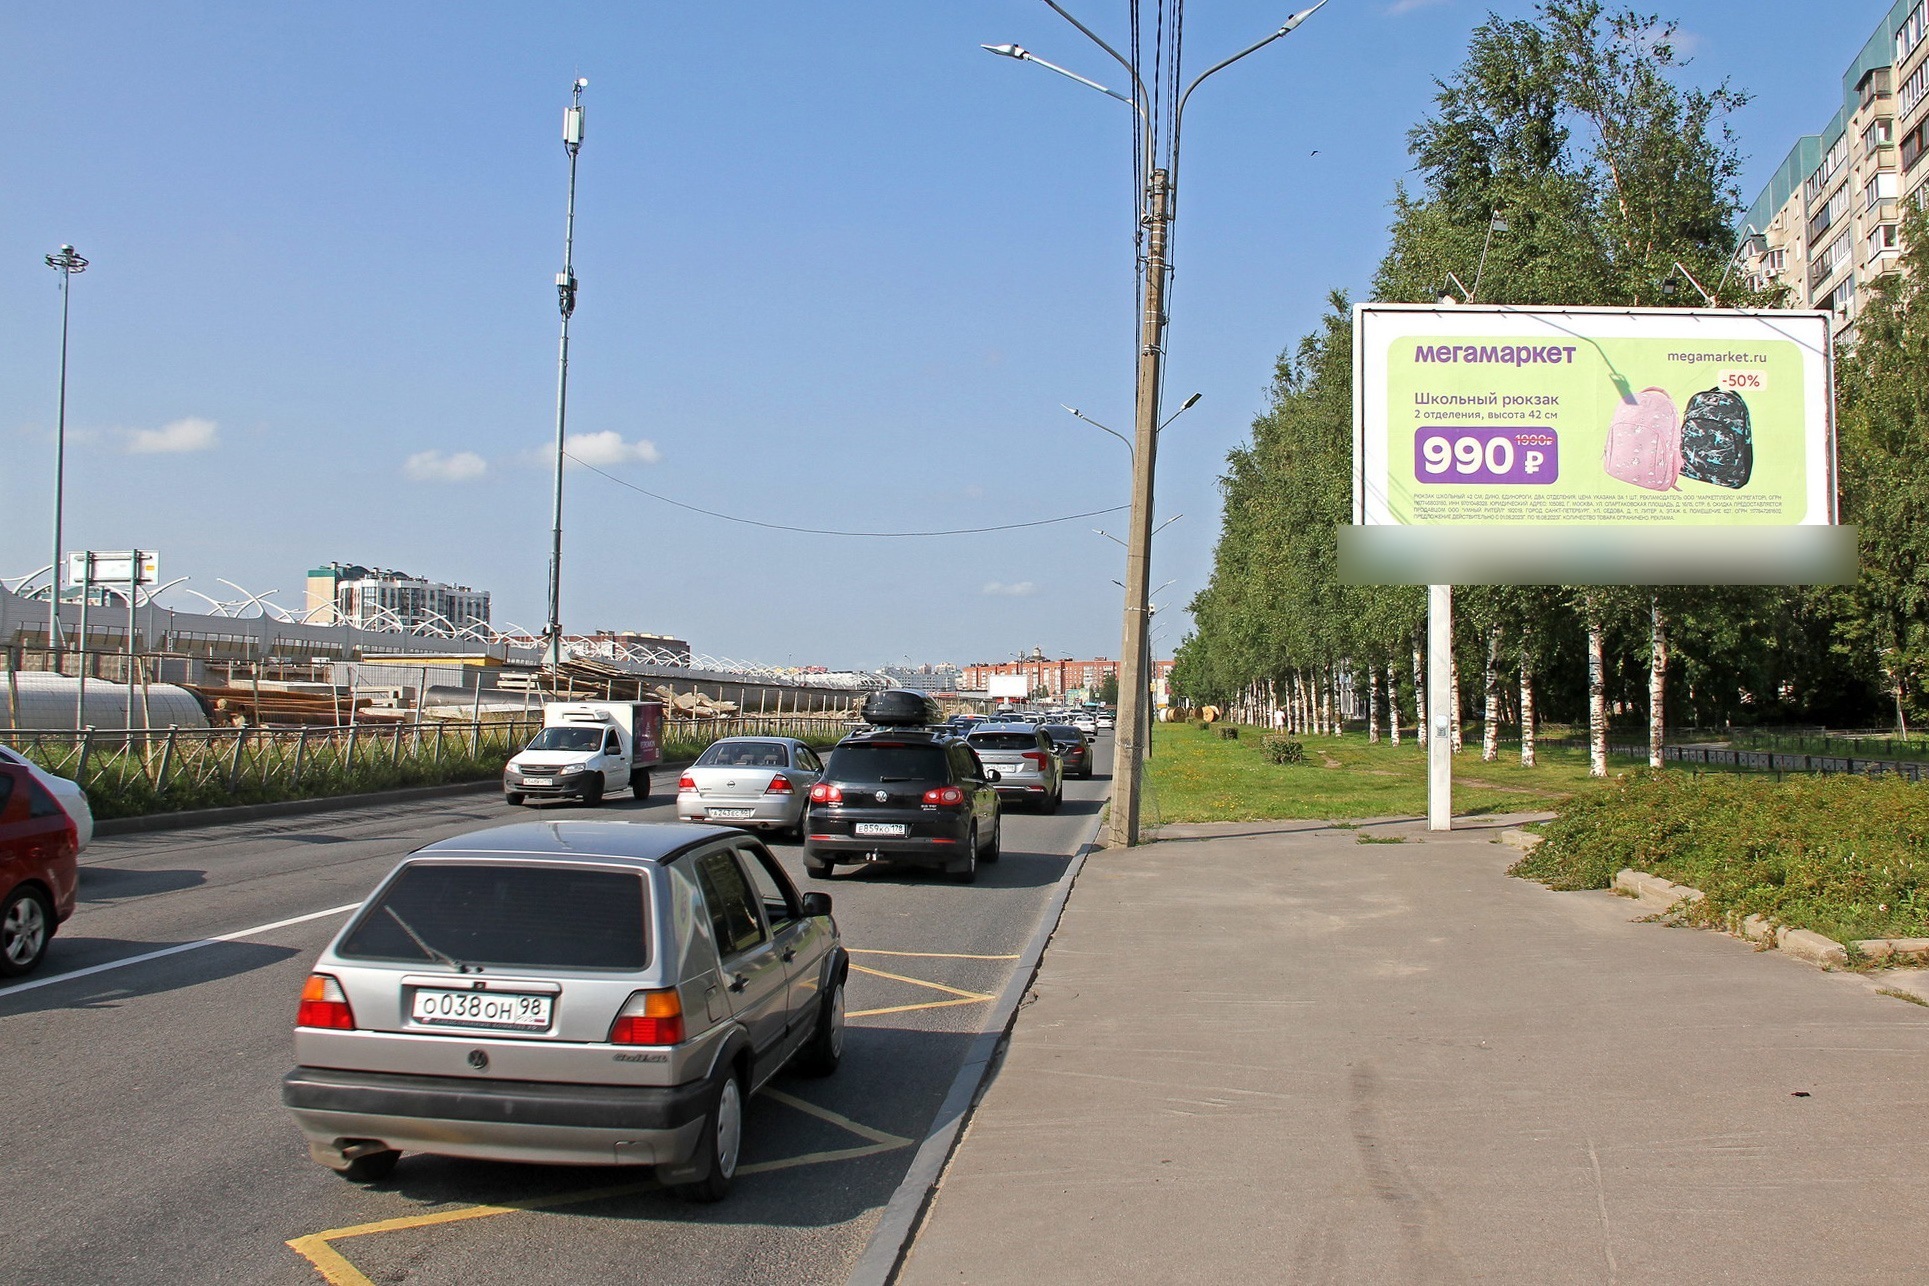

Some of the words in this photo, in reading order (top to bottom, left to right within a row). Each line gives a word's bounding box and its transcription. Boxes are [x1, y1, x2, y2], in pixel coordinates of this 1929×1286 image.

[1414, 345, 1577, 368] мегамаркет
[1667, 351, 1767, 364] megamarket.ru
[1722, 374, 1760, 388] -50%
[1414, 391, 1498, 406] Школьный
[1502, 394, 1559, 408] рюкзак
[1414, 409, 1421, 419] 2
[1423, 411, 1485, 421] отделения,
[1487, 411, 1526, 420] высота
[1528, 410, 1542, 420] 42
[1544, 412, 1558, 420] см
[1422, 435, 1515, 475] 990
[423, 993, 513, 1020] О038ОН
[519, 997, 542, 1015] 98
